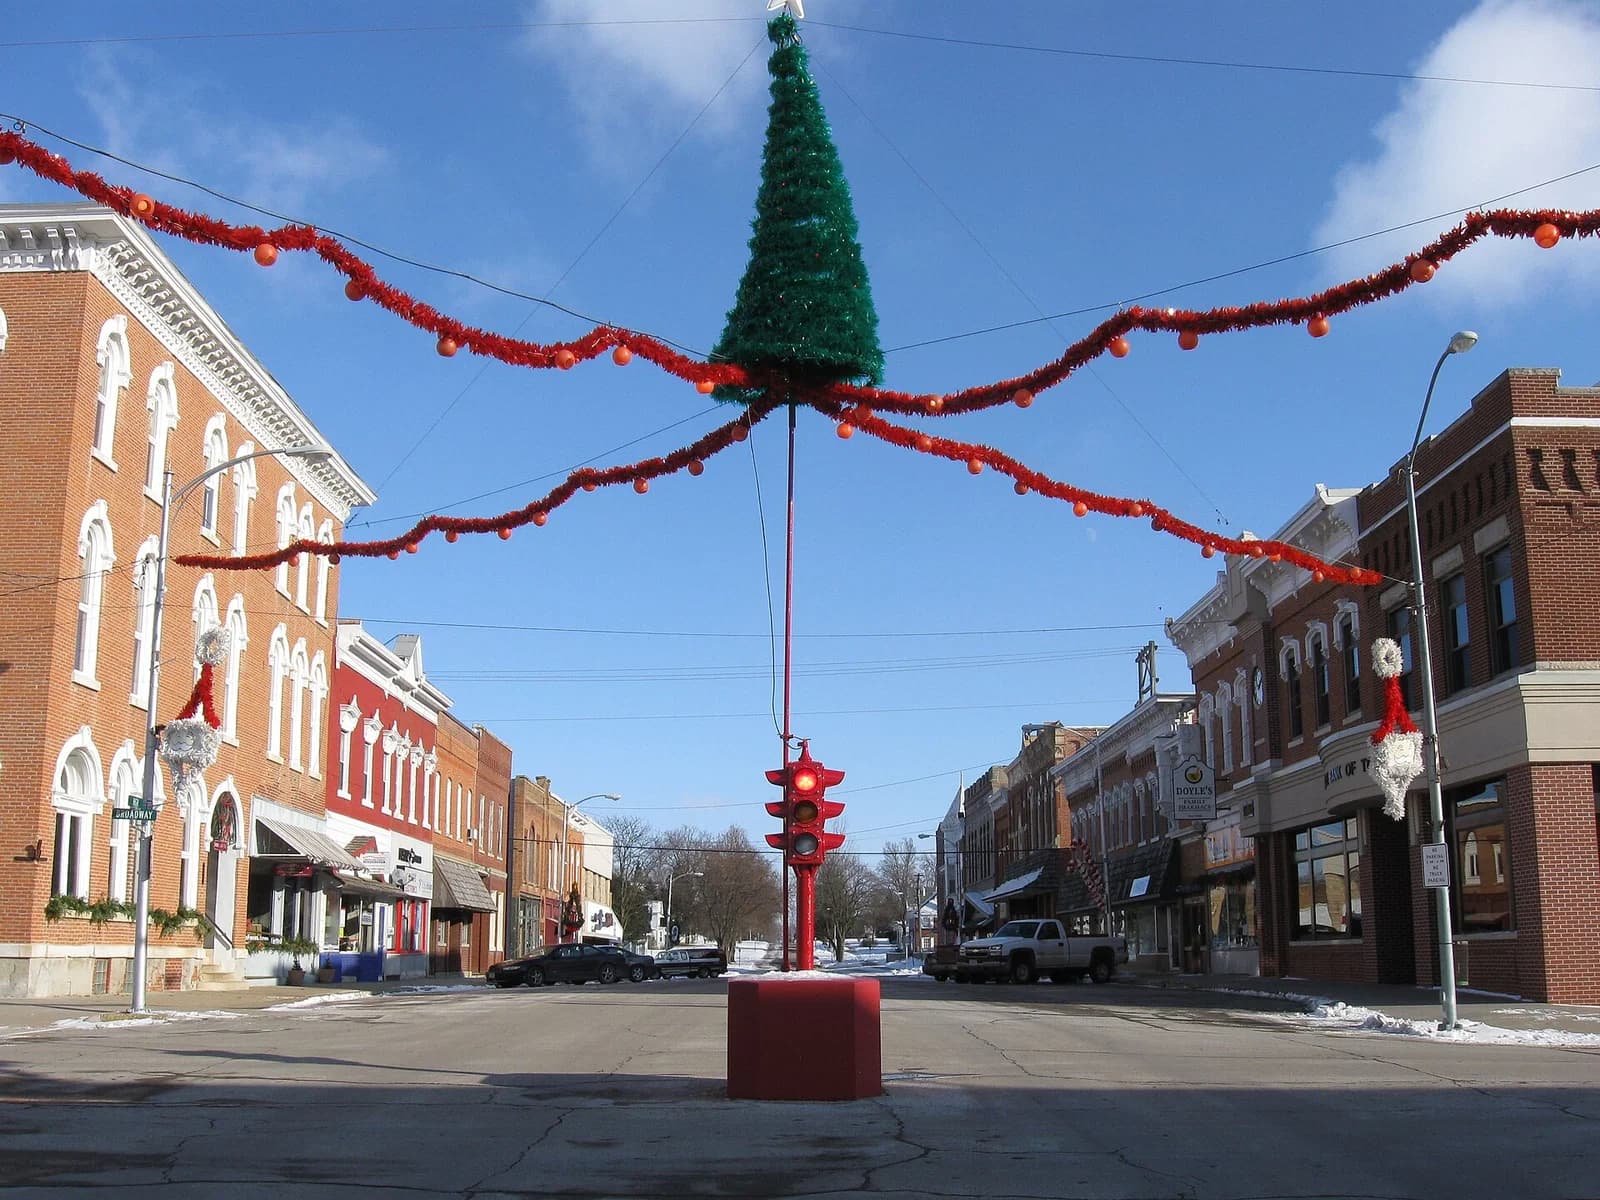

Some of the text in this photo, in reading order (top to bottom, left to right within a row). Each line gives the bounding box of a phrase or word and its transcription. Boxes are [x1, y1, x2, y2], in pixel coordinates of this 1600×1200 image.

[1345, 760, 1357, 776] OF
[1176, 785, 1213, 795] DOYLE'S
[115, 809, 154, 819] BROADWAY
